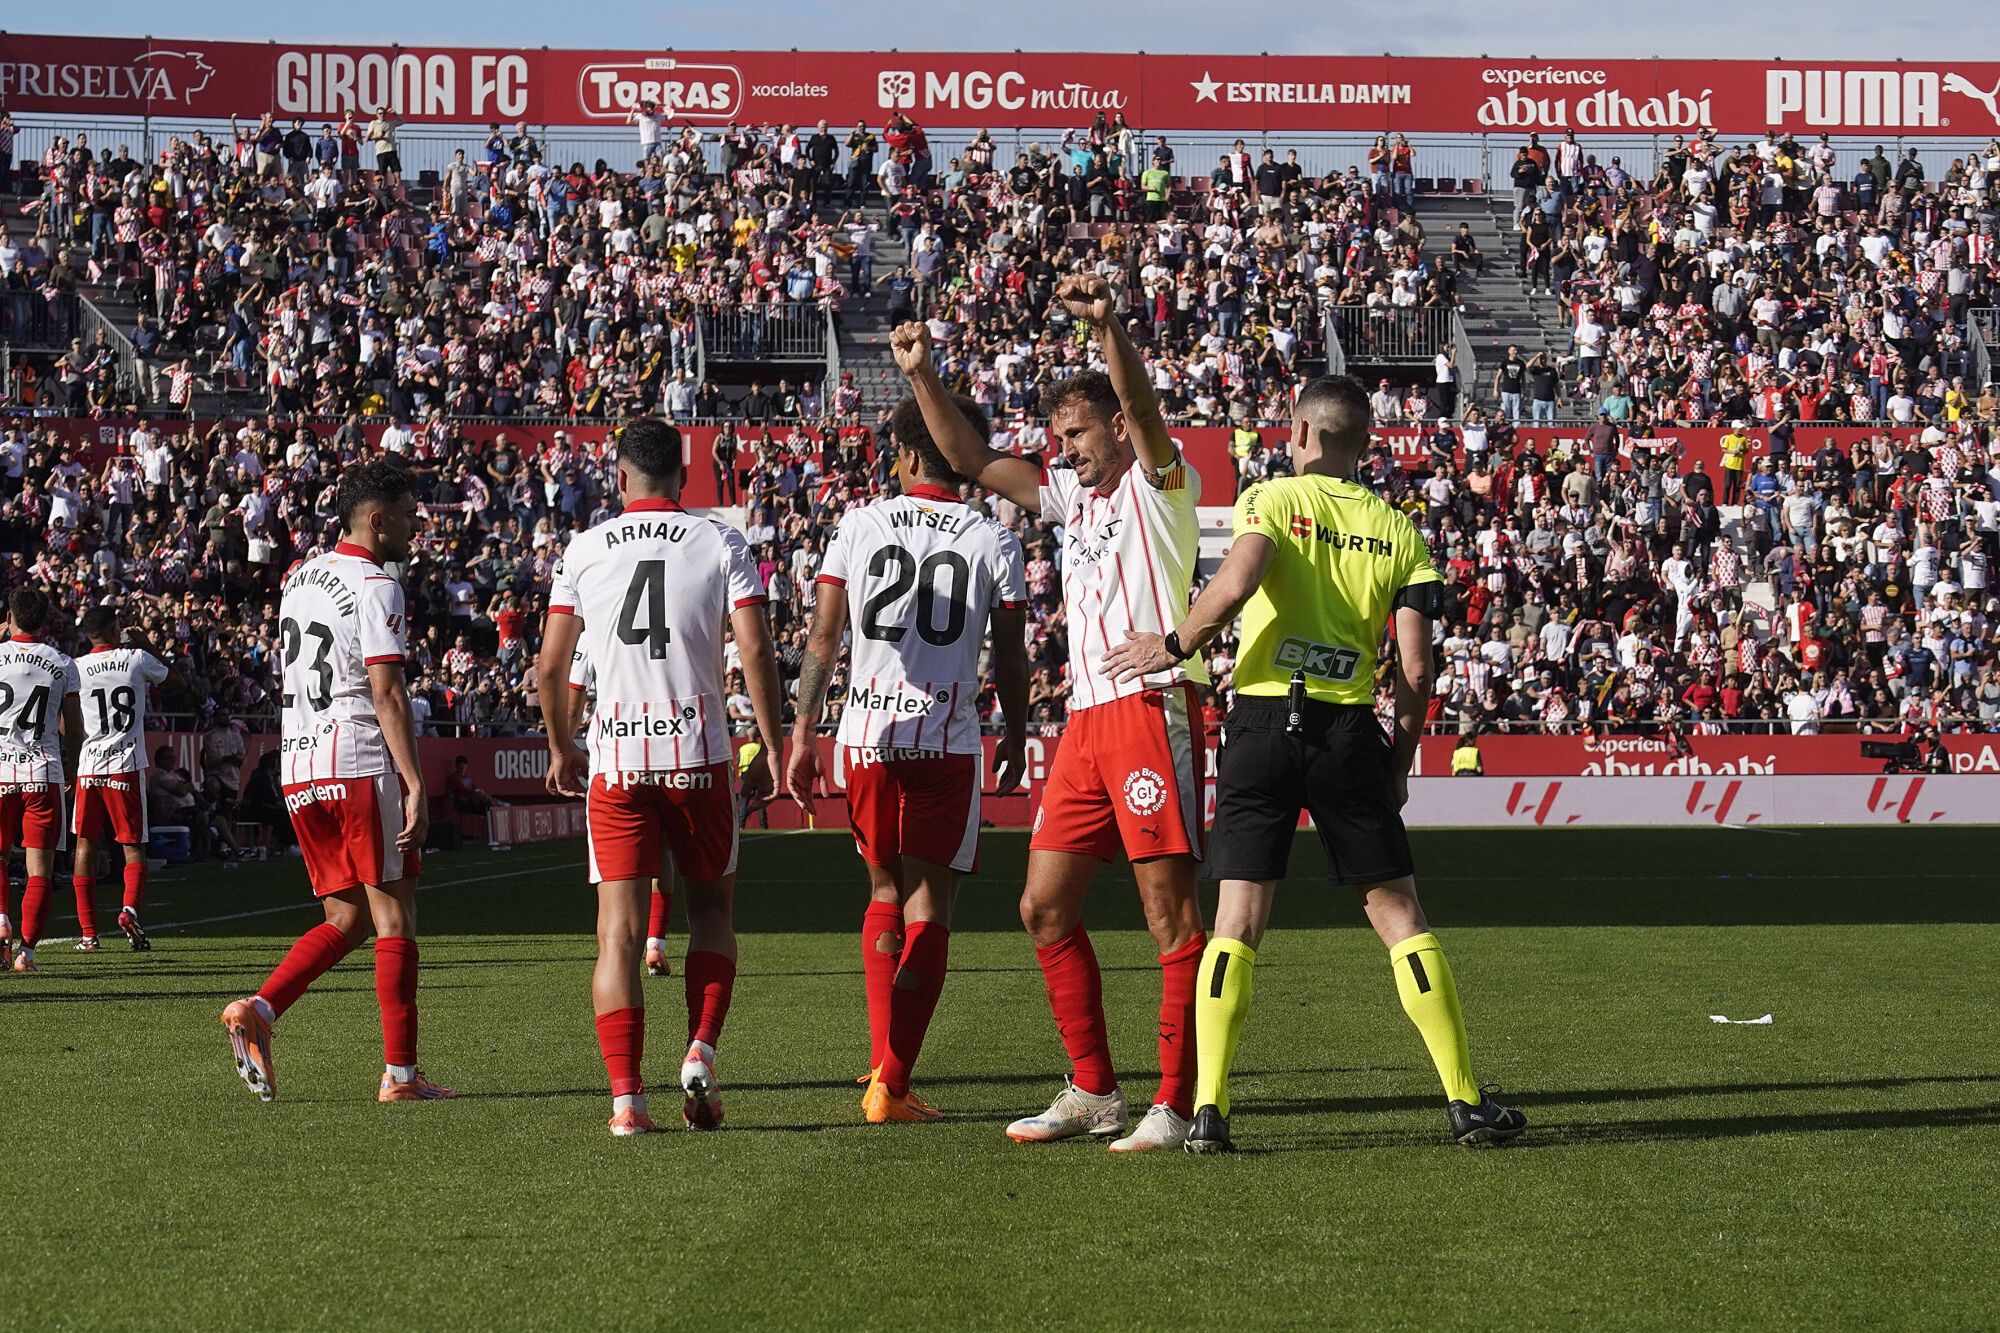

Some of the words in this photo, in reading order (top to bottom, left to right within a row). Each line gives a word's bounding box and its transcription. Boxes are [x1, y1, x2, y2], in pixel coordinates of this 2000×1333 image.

[650, 60, 671, 69] 1890
[0, 62, 177, 100] FRISELVA
[277, 51, 456, 115] GIRONA
[471, 55, 528, 117] FC
[590, 71, 731, 110] TORRAS
[751, 82, 829, 98] xocolates
[925, 70, 1026, 110] MGC
[1226, 82, 1336, 104] ESTRELLA
[1339, 83, 1412, 104] DAMM
[1477, 88, 1568, 127] abu
[1766, 69, 1940, 127] PUMA
[605, 521, 689, 549] ARNAU
[889, 509, 962, 535] WITSEL
[1316, 523, 1393, 557] WÜRTH
[616, 559, 671, 660] 4
[861, 544, 970, 647] 20
[15, 653, 64, 681] MORENO
[86, 660, 130, 677] OUNAHI
[280, 616, 335, 713] 23
[1279, 642, 1356, 676] BKT
[0, 681, 51, 741] 24
[90, 684, 137, 735] 18
[850, 686, 934, 716] Marlex
[600, 714, 685, 741] Marlex
[87, 745, 127, 759] Marlex
[283, 733, 319, 753] arlex
[0, 751, 35, 764] arlex
[86, 778, 131, 792] parlem
[622, 771, 713, 791] parlem
[1141, 767, 1165, 787] Brava
[1137, 786, 1152, 800] G!
